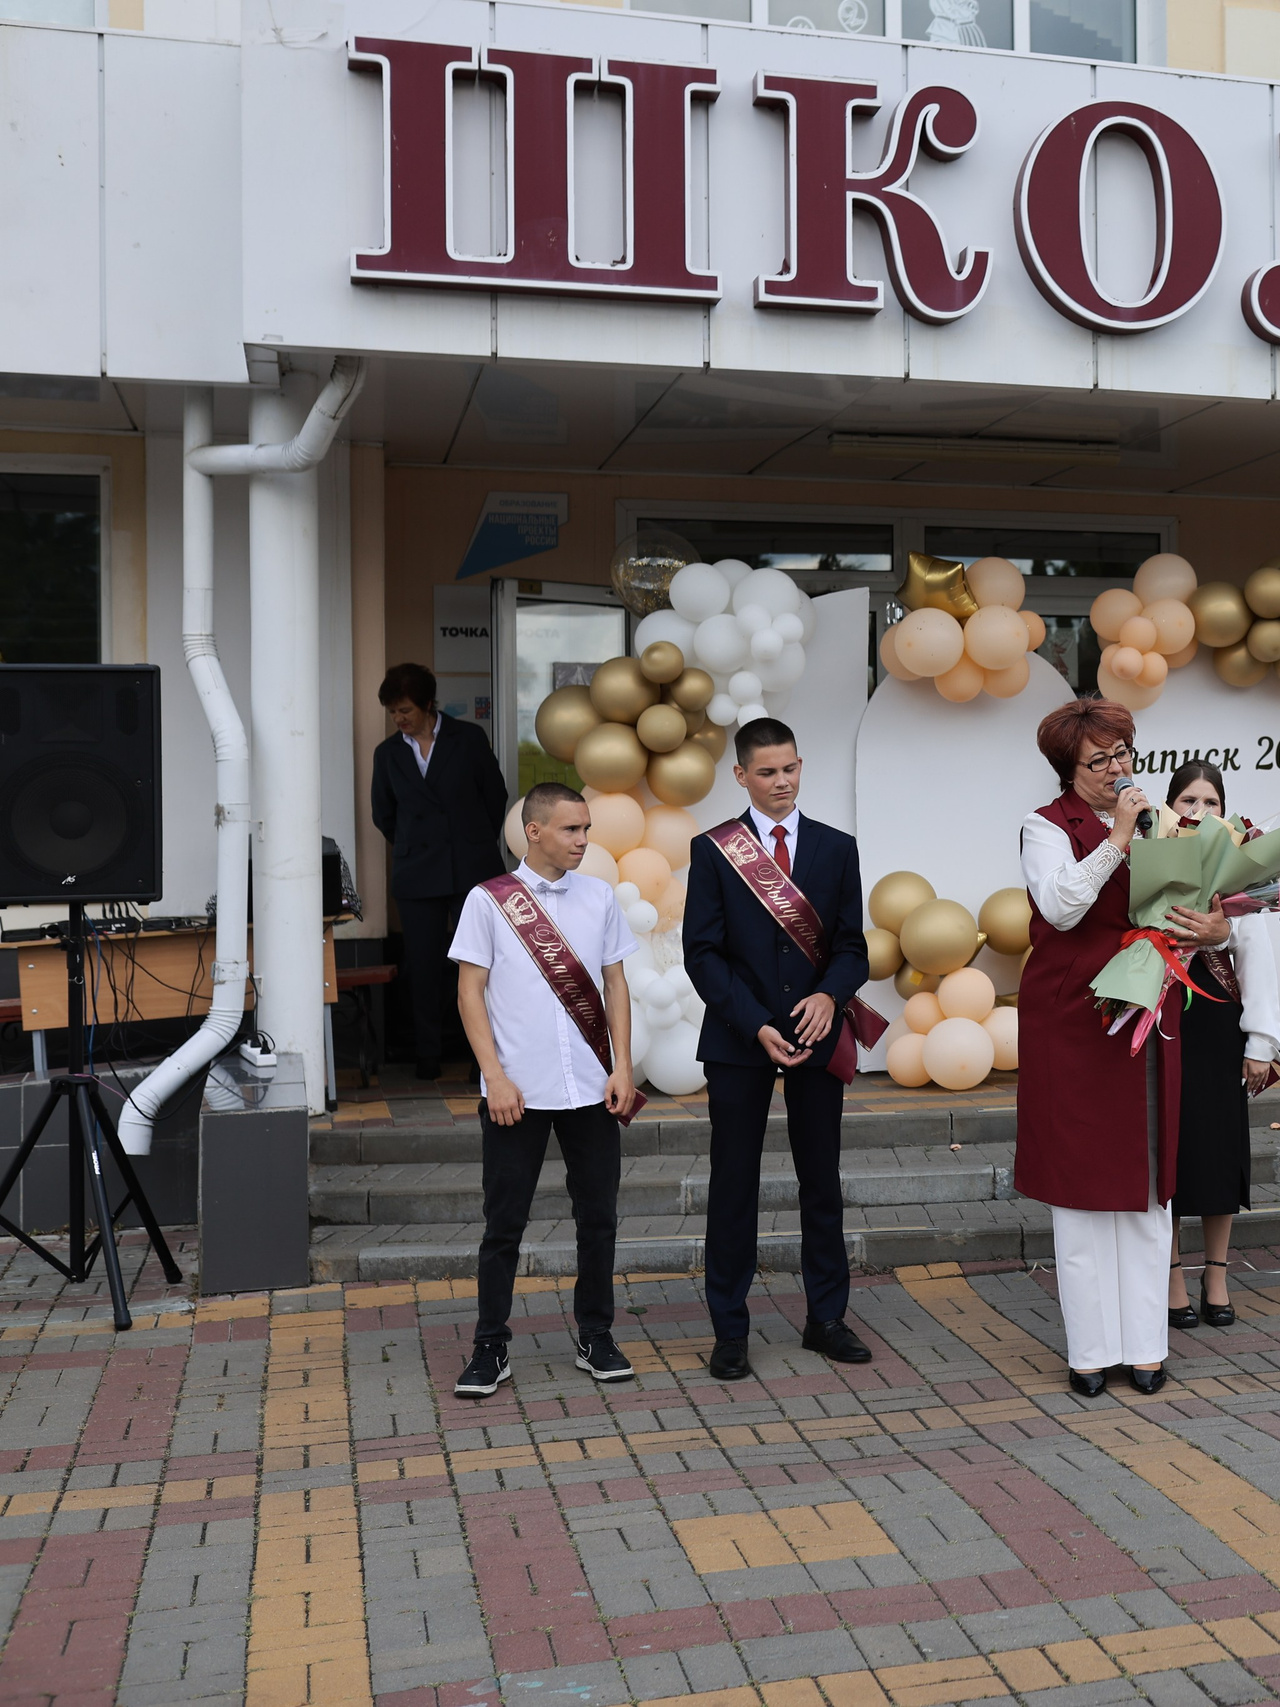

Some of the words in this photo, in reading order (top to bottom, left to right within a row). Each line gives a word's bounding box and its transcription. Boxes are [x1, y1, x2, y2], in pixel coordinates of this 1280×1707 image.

[499, 499, 558, 508] ОБРАЗОВАНИЕ
[488, 513, 557, 526] НАЦИОНАЛЬНЫЕ
[517, 525, 557, 536] ПРОЕКТЫ
[525, 535, 557, 546] РОССИИ
[440, 626, 489, 638] ТОЧКА
[1132, 748, 1241, 775] ыпск
[529, 923, 598, 1026] Выпускник
